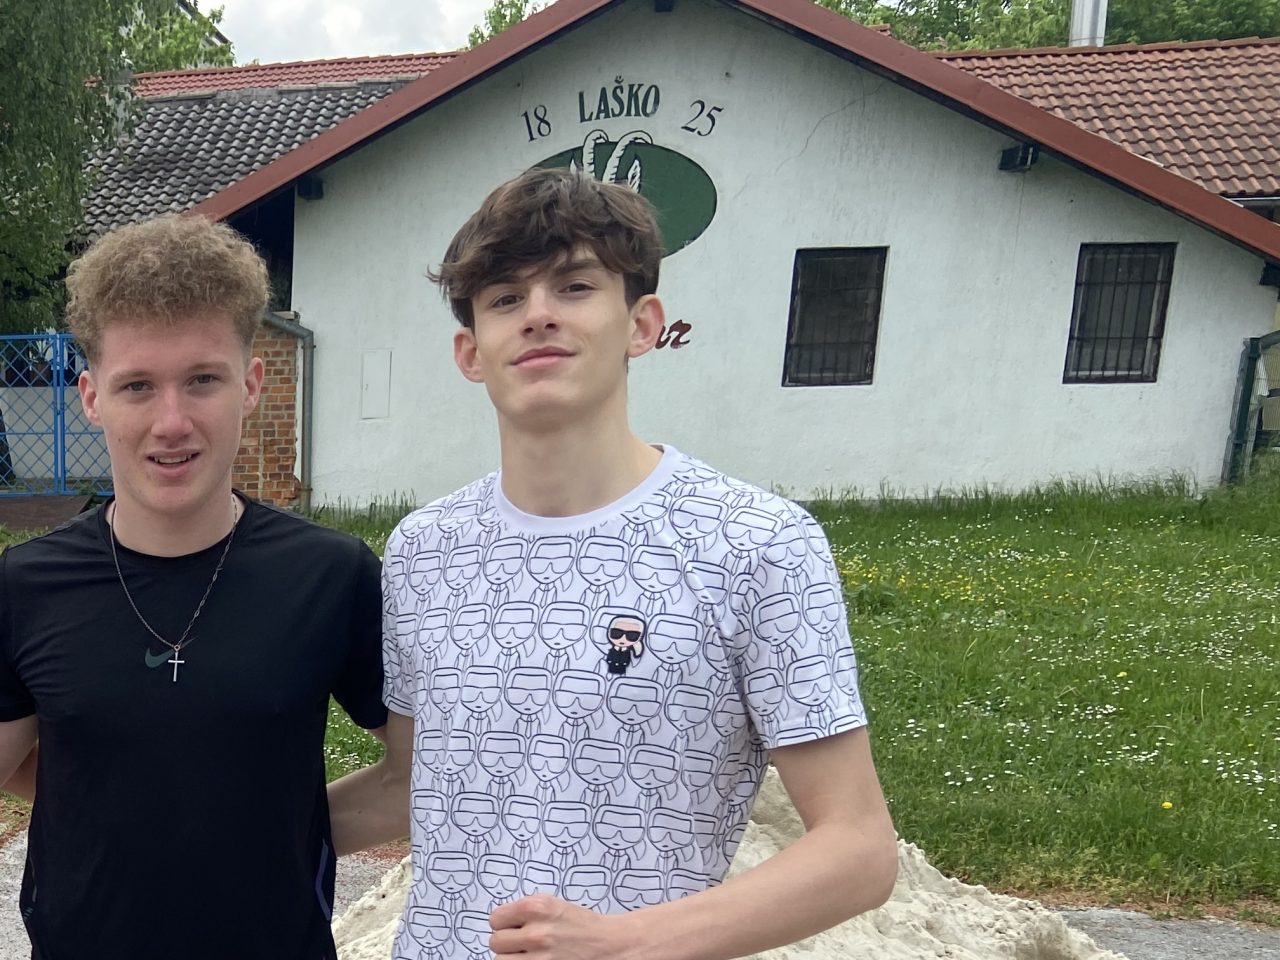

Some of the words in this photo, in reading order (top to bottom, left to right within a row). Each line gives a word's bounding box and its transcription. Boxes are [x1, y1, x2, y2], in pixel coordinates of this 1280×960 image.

[521, 104, 552, 142] 18
[578, 75, 661, 123] LAŠKO
[681, 99, 724, 137] 25
